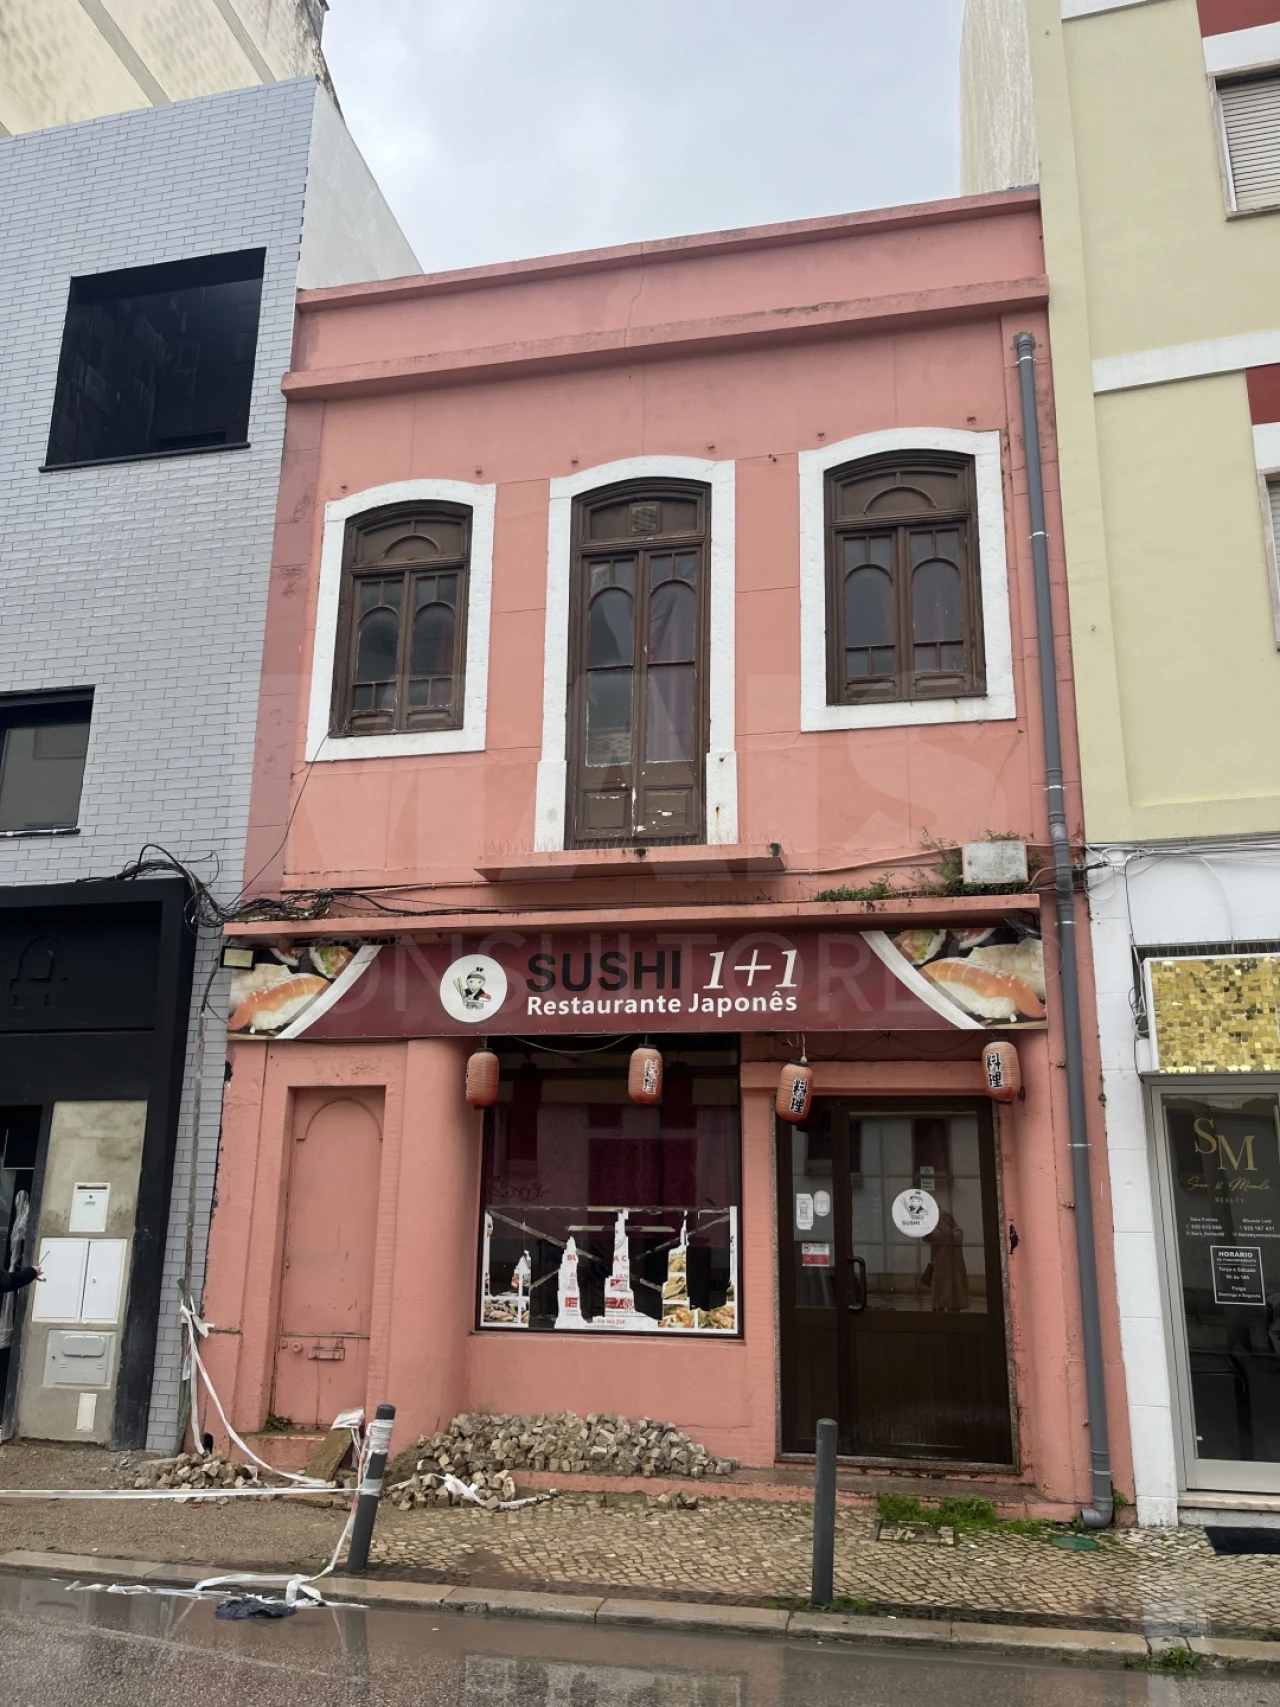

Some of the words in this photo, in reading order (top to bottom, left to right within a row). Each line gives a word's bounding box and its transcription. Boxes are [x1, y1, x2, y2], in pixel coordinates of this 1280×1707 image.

[526, 951, 681, 992] SUSHI
[702, 949, 798, 990] 1+1
[527, 994, 682, 1016] Restaurante
[688, 991, 798, 1018] Japonês
[1218, 1251, 1254, 1259] HORÁRIO
